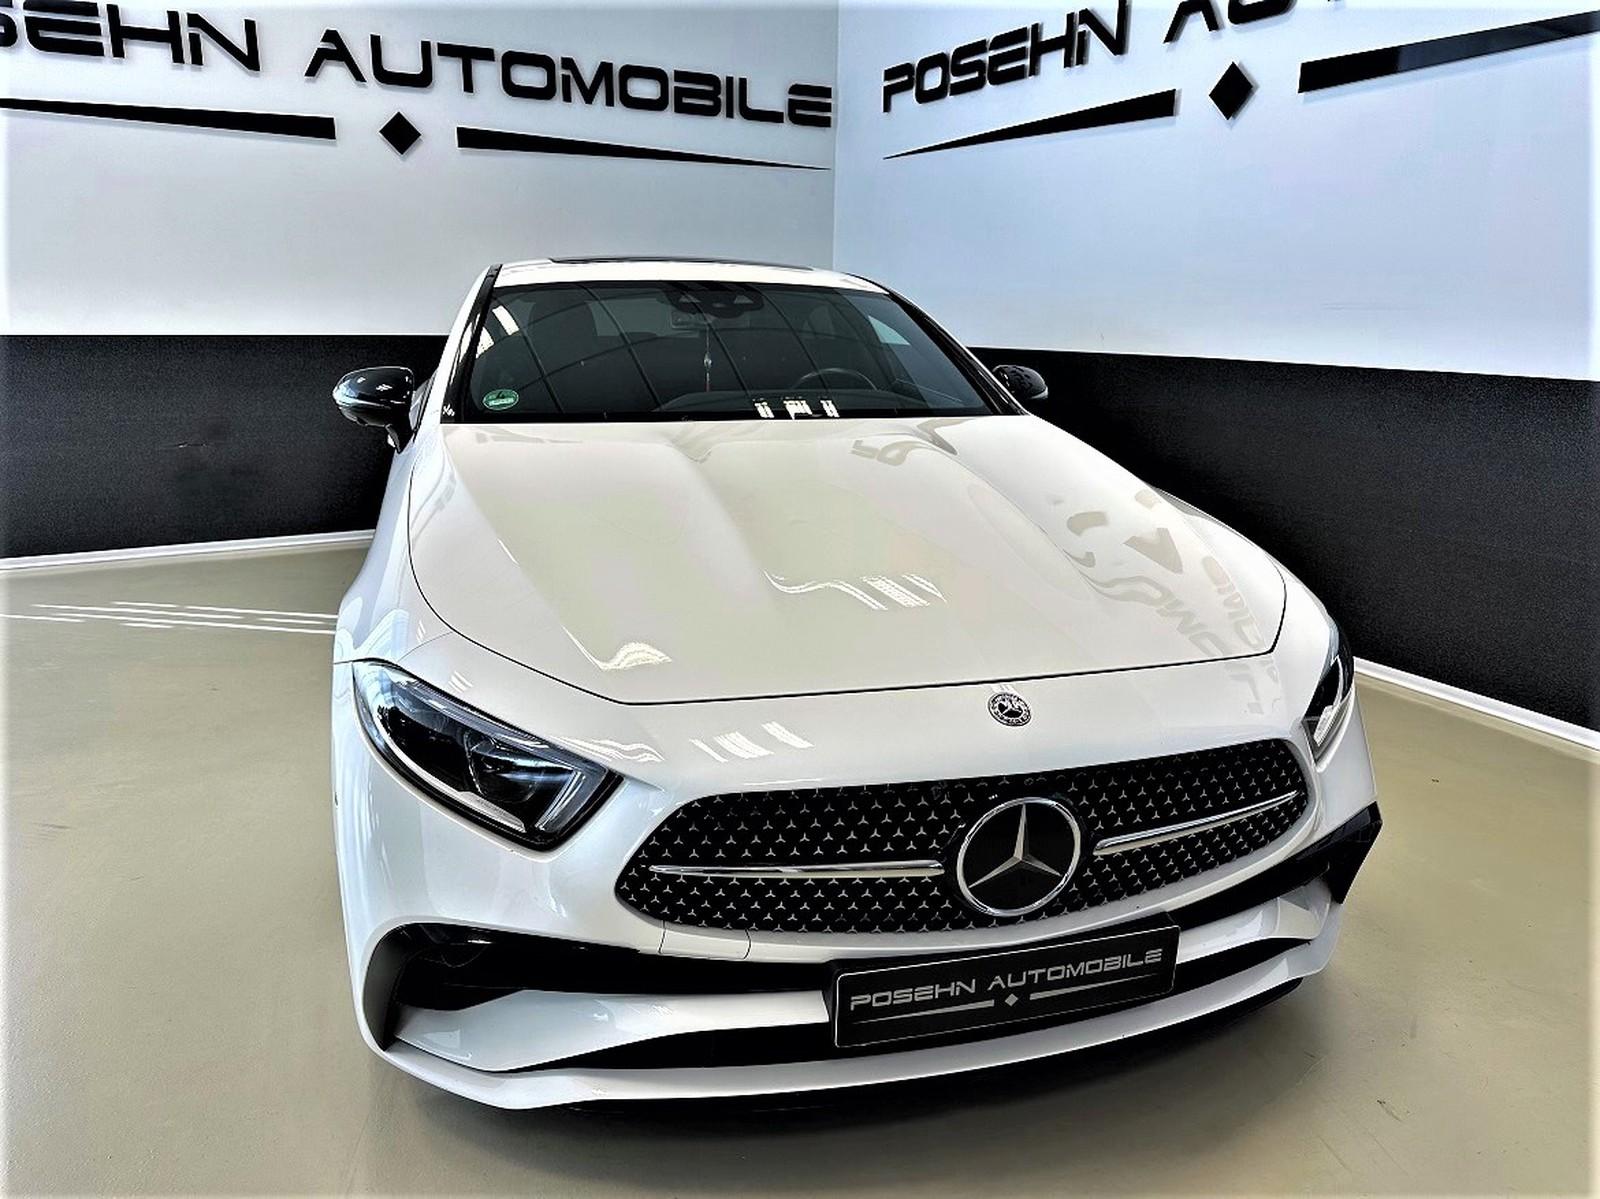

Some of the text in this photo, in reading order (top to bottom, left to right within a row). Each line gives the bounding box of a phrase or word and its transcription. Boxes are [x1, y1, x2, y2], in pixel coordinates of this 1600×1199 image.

[0, 0, 833, 128] EHN AUTOMOBILE
[882, 0, 1128, 113] POSEHN
[850, 948, 1163, 1011] POSEHN AUTOMOBILE
